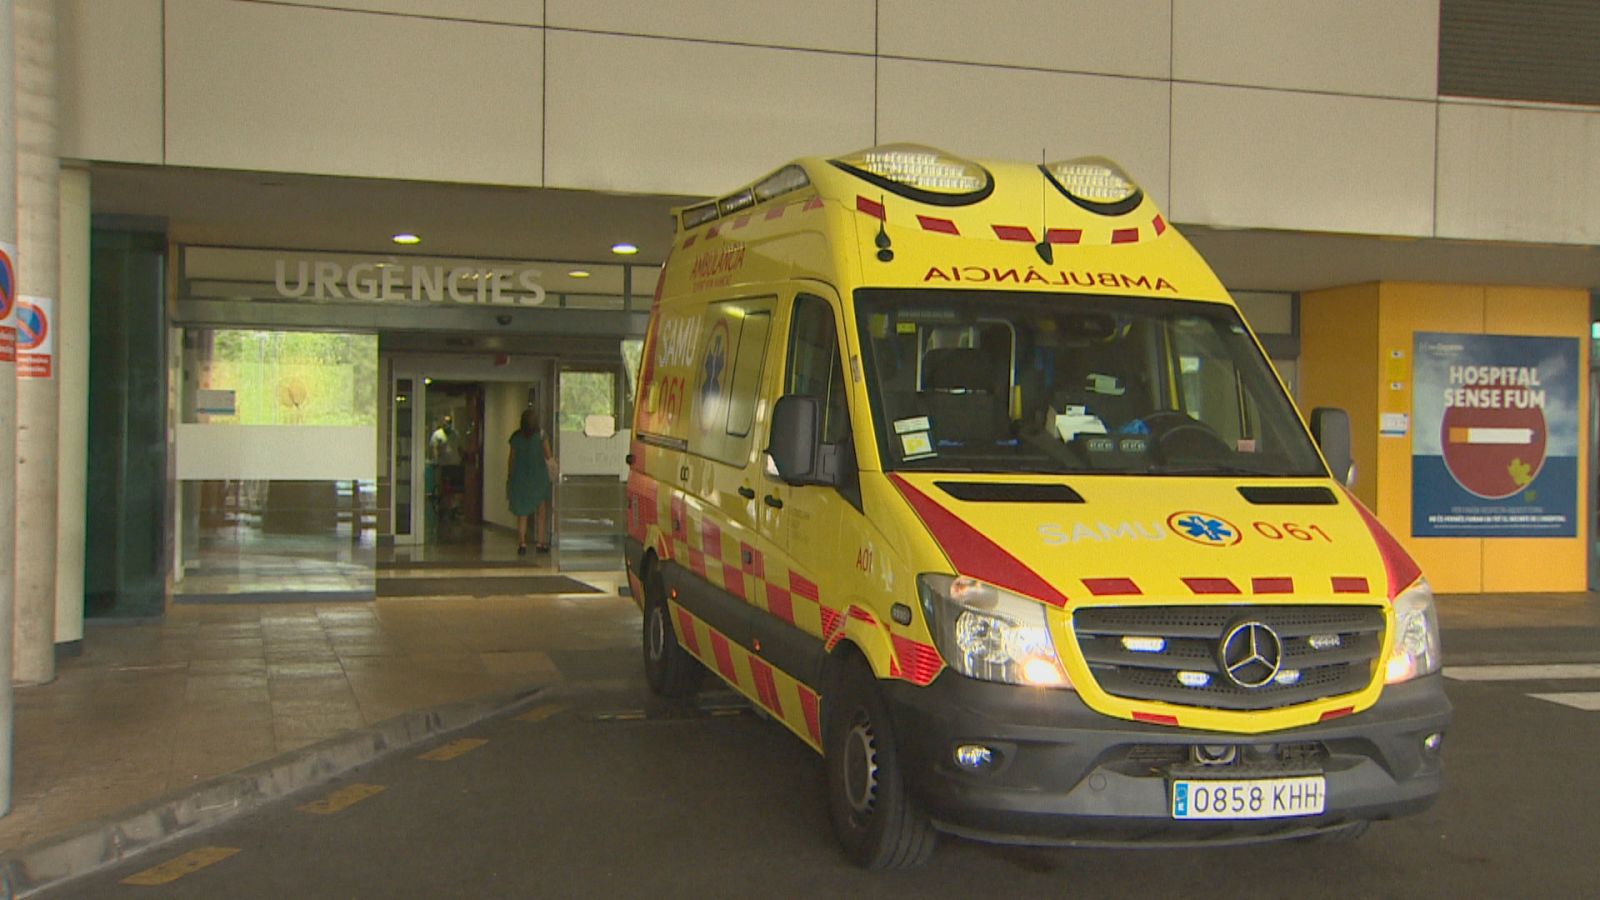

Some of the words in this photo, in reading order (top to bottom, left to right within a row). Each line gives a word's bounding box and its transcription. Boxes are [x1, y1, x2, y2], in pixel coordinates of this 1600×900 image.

[275, 256, 546, 305] URGÈNCIES
[659, 314, 702, 368] SAMU
[1449, 366, 1540, 386] HOSPITAL
[658, 374, 686, 427] 061
[1444, 388, 1501, 408] SENSE
[1504, 389, 1546, 409] FUM
[1038, 519, 1167, 546] SAMU
[1253, 521, 1332, 543] 061
[856, 547, 873, 573] A01
[1194, 786, 1262, 812] 0858
[1273, 783, 1318, 811] KHH
